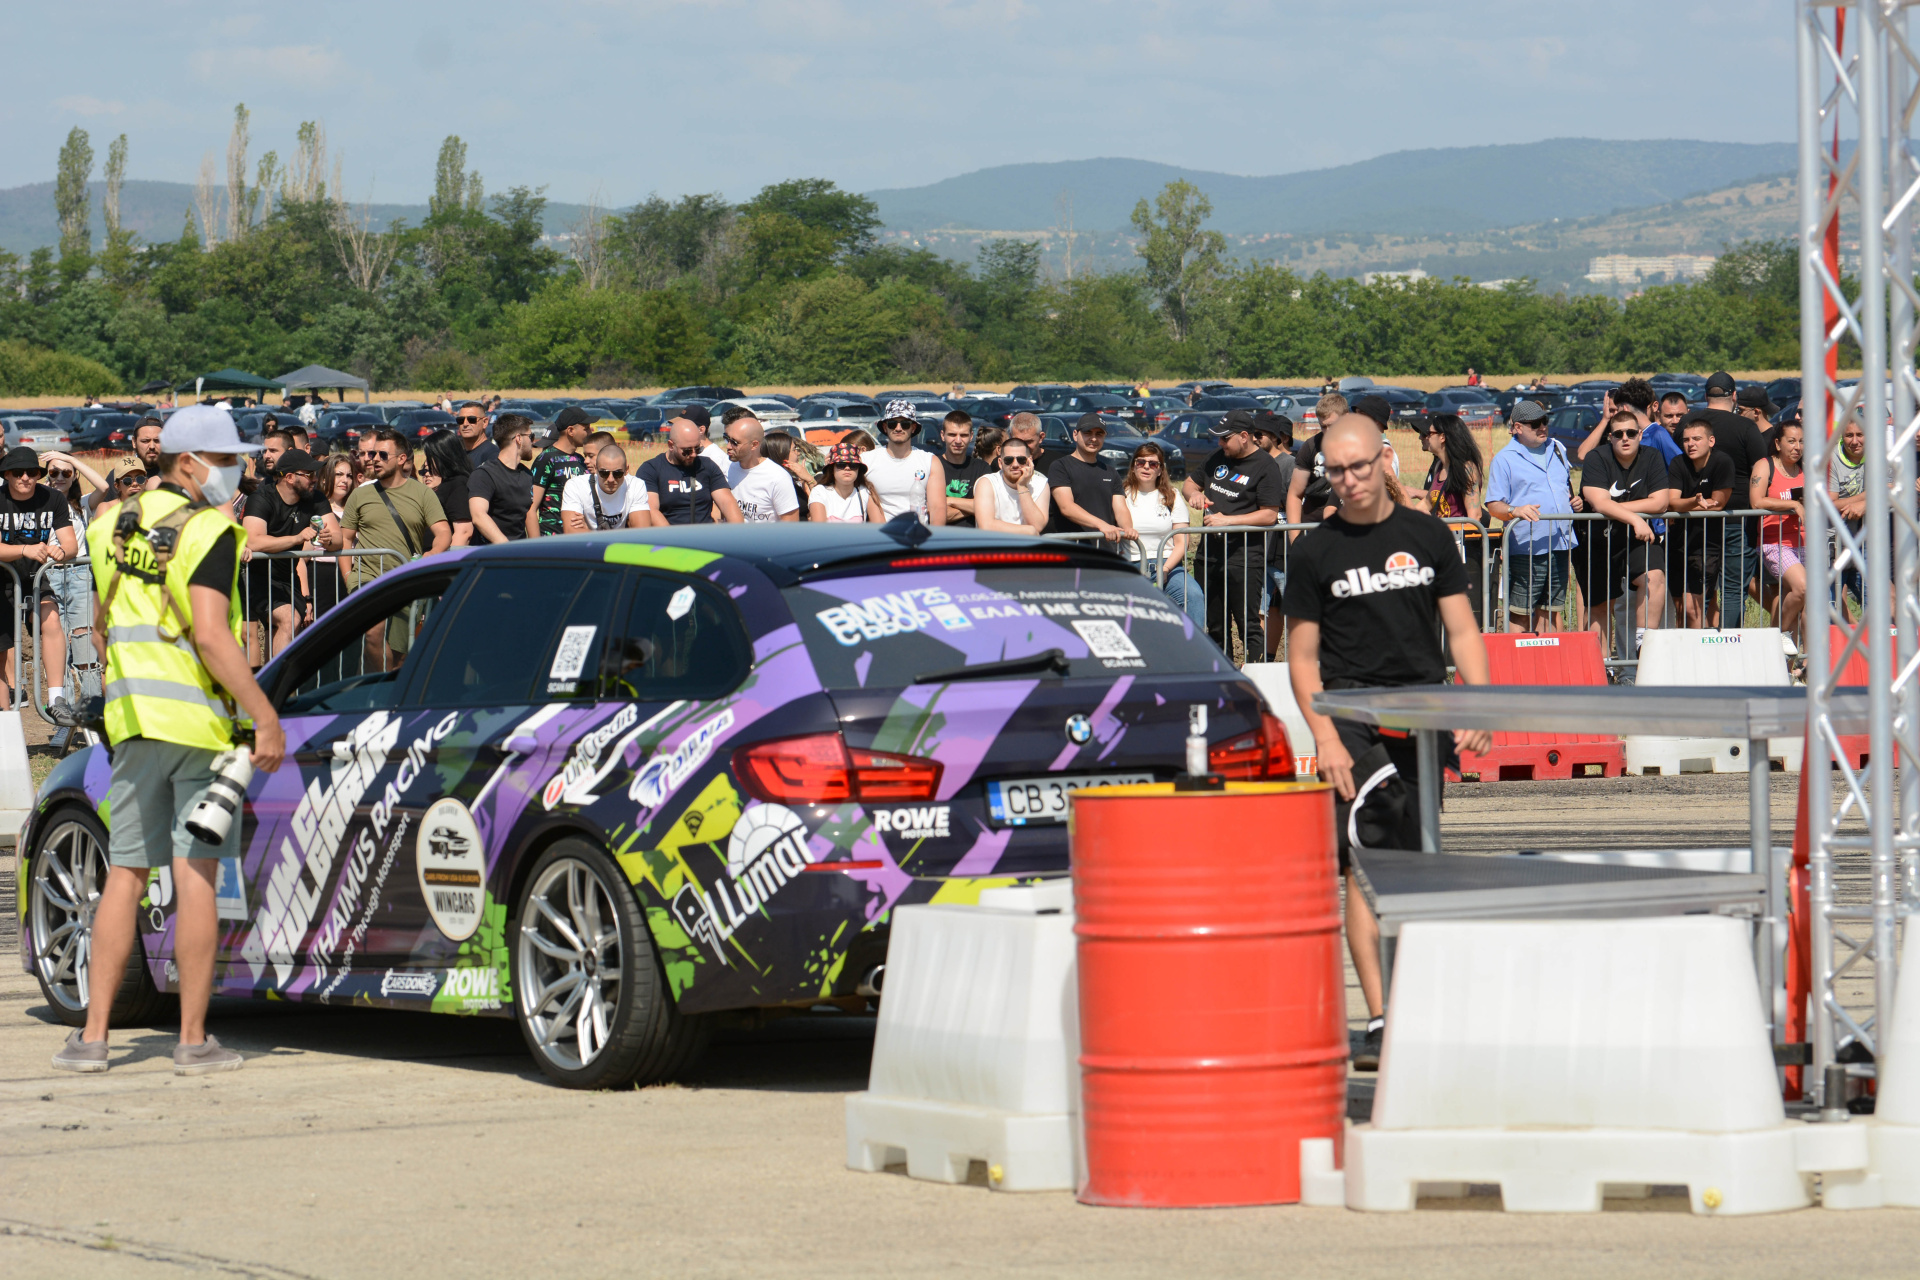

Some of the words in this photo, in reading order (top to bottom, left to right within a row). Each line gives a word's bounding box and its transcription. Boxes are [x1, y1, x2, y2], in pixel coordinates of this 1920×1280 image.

[105, 546, 159, 571] MEDIA
[1331, 566, 1435, 598] ellesse
[1022, 603, 1043, 616] И
[565, 703, 636, 785] UniCredit
[672, 715, 729, 774] DIANA
[370, 711, 459, 840] RACING
[1007, 784, 1044, 815] CB
[874, 805, 950, 832] ROWE
[267, 716, 402, 990] BULGARIA
[352, 886, 382, 933] Through
[376, 811, 411, 888] Motorsport
[240, 834, 301, 986] BMW
[434, 890, 476, 914] WINCARS
[443, 967, 499, 997] ROWE
